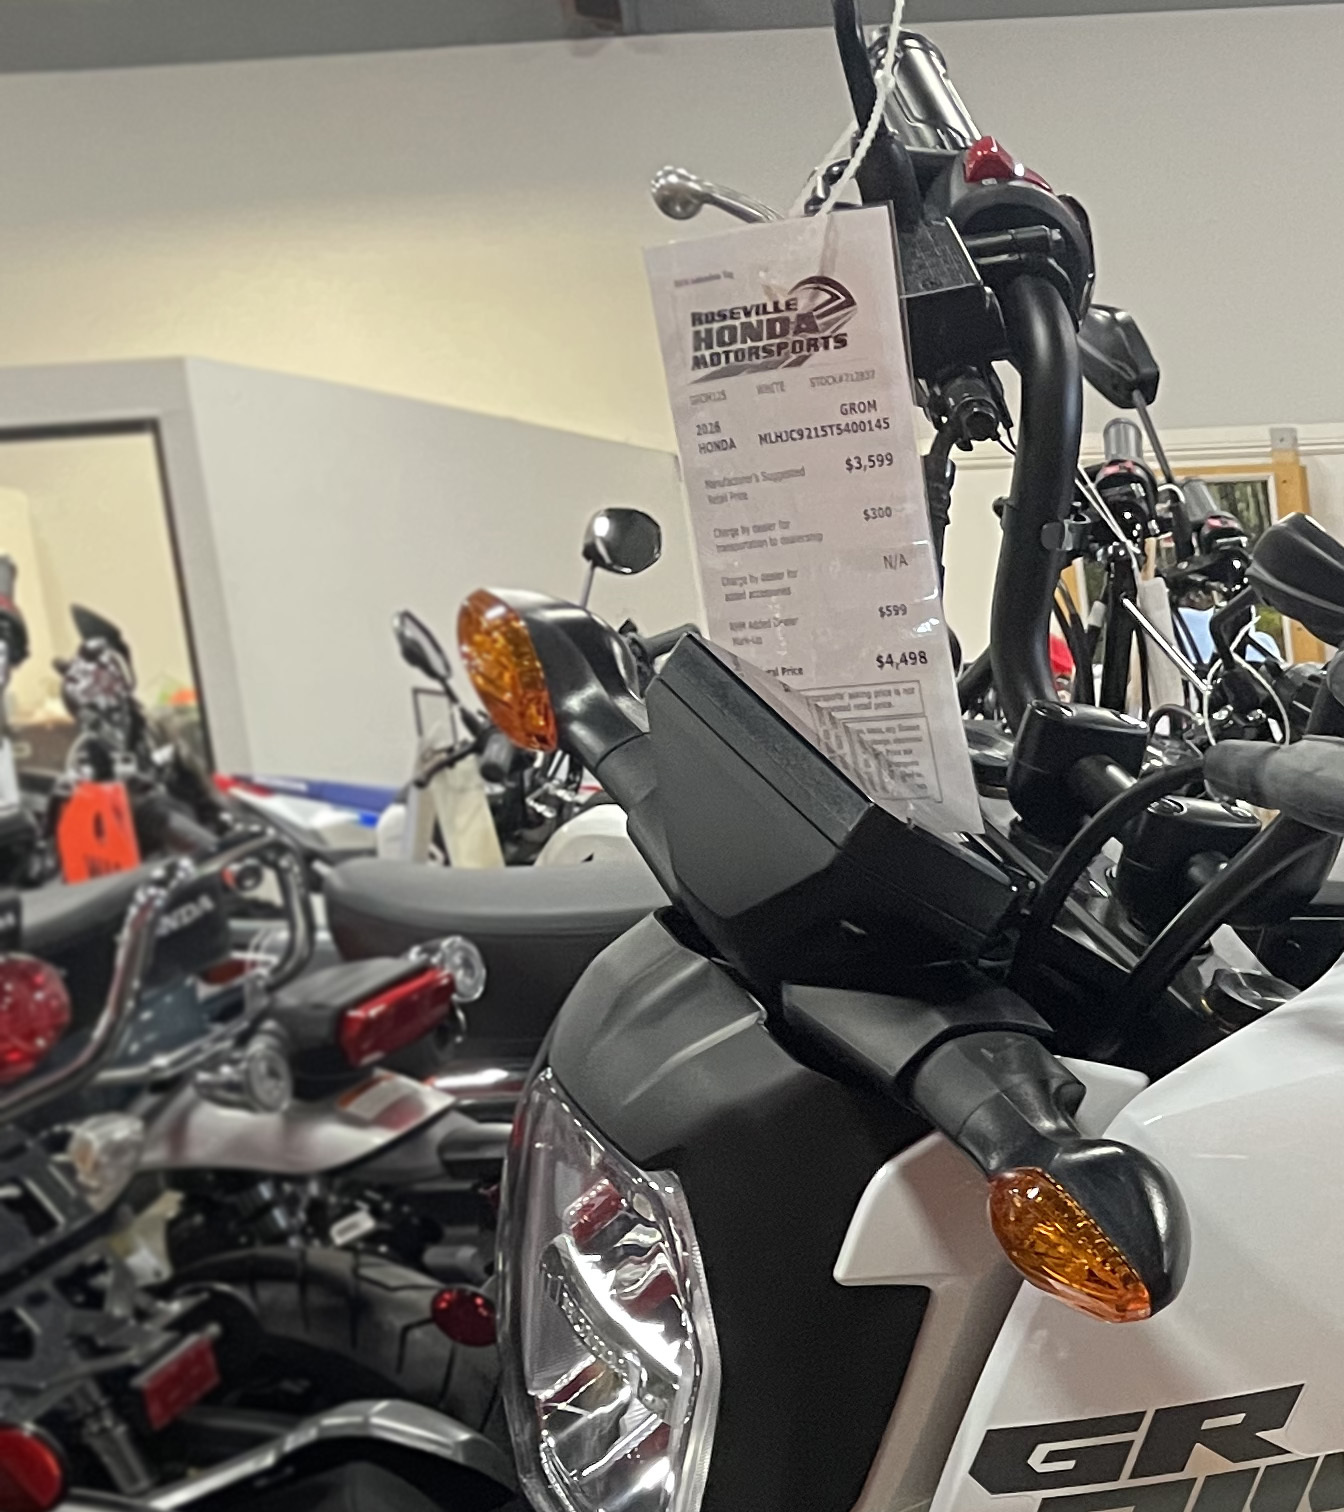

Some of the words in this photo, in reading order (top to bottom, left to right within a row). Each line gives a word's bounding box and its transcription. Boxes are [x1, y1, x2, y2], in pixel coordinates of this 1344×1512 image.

[690, 297, 799, 327] ROSEVILLE
[692, 311, 821, 353] HONDA
[690, 332, 848, 371] MOTORSPORTS
[839, 400, 879, 416] GROM
[698, 437, 738, 454] HONDA
[845, 452, 894, 474] $3,599
[862, 506, 893, 521] $300
[883, 553, 909, 570] N/A
[875, 650, 929, 671] $4,498
